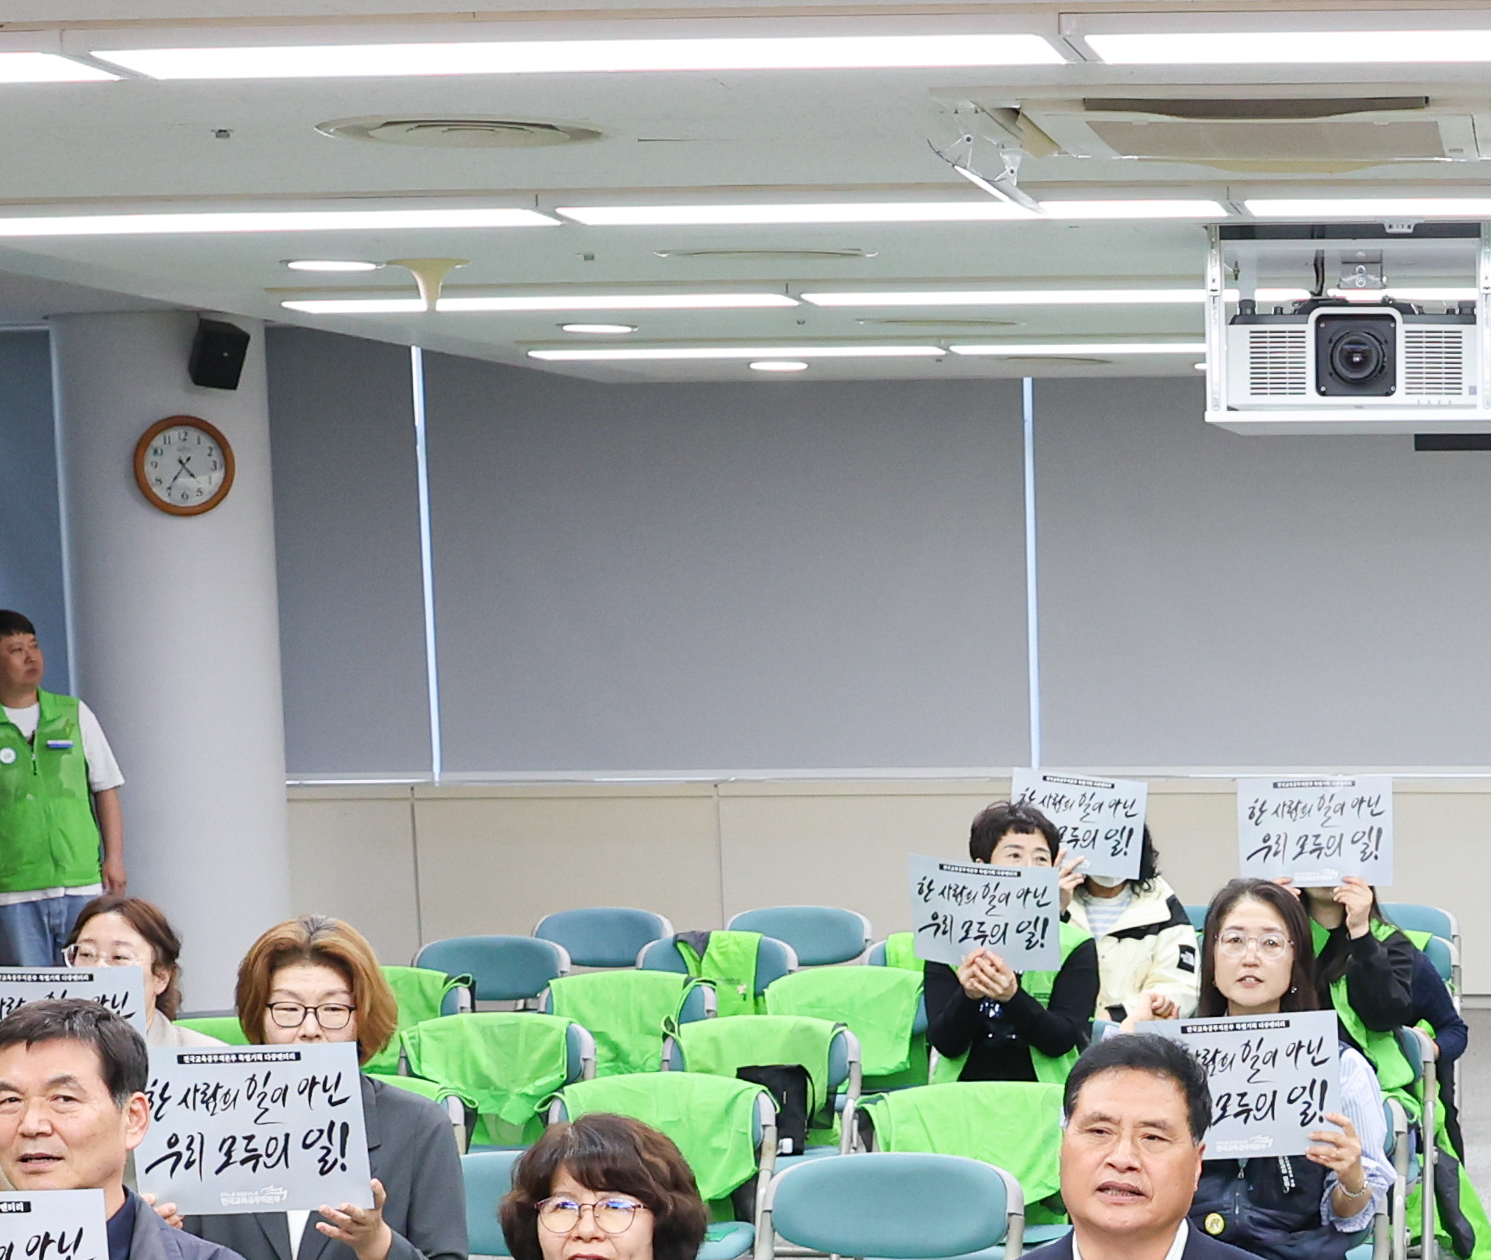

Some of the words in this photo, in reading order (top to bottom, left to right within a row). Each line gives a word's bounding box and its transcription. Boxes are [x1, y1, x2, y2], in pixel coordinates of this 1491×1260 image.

[916, 876, 935, 903] 한
[936, 884, 978, 905] 사람의
[982, 881, 1010, 915] 일이
[1017, 885, 1051, 909] 아닌
[176, 1082, 240, 1116] 사람의
[245, 1070, 288, 1125] 일이
[298, 1071, 349, 1110] 아닌
[142, 1132, 204, 1181] 우리
[214, 1133, 290, 1174] 모두의
[302, 1119, 348, 1177] 일!
